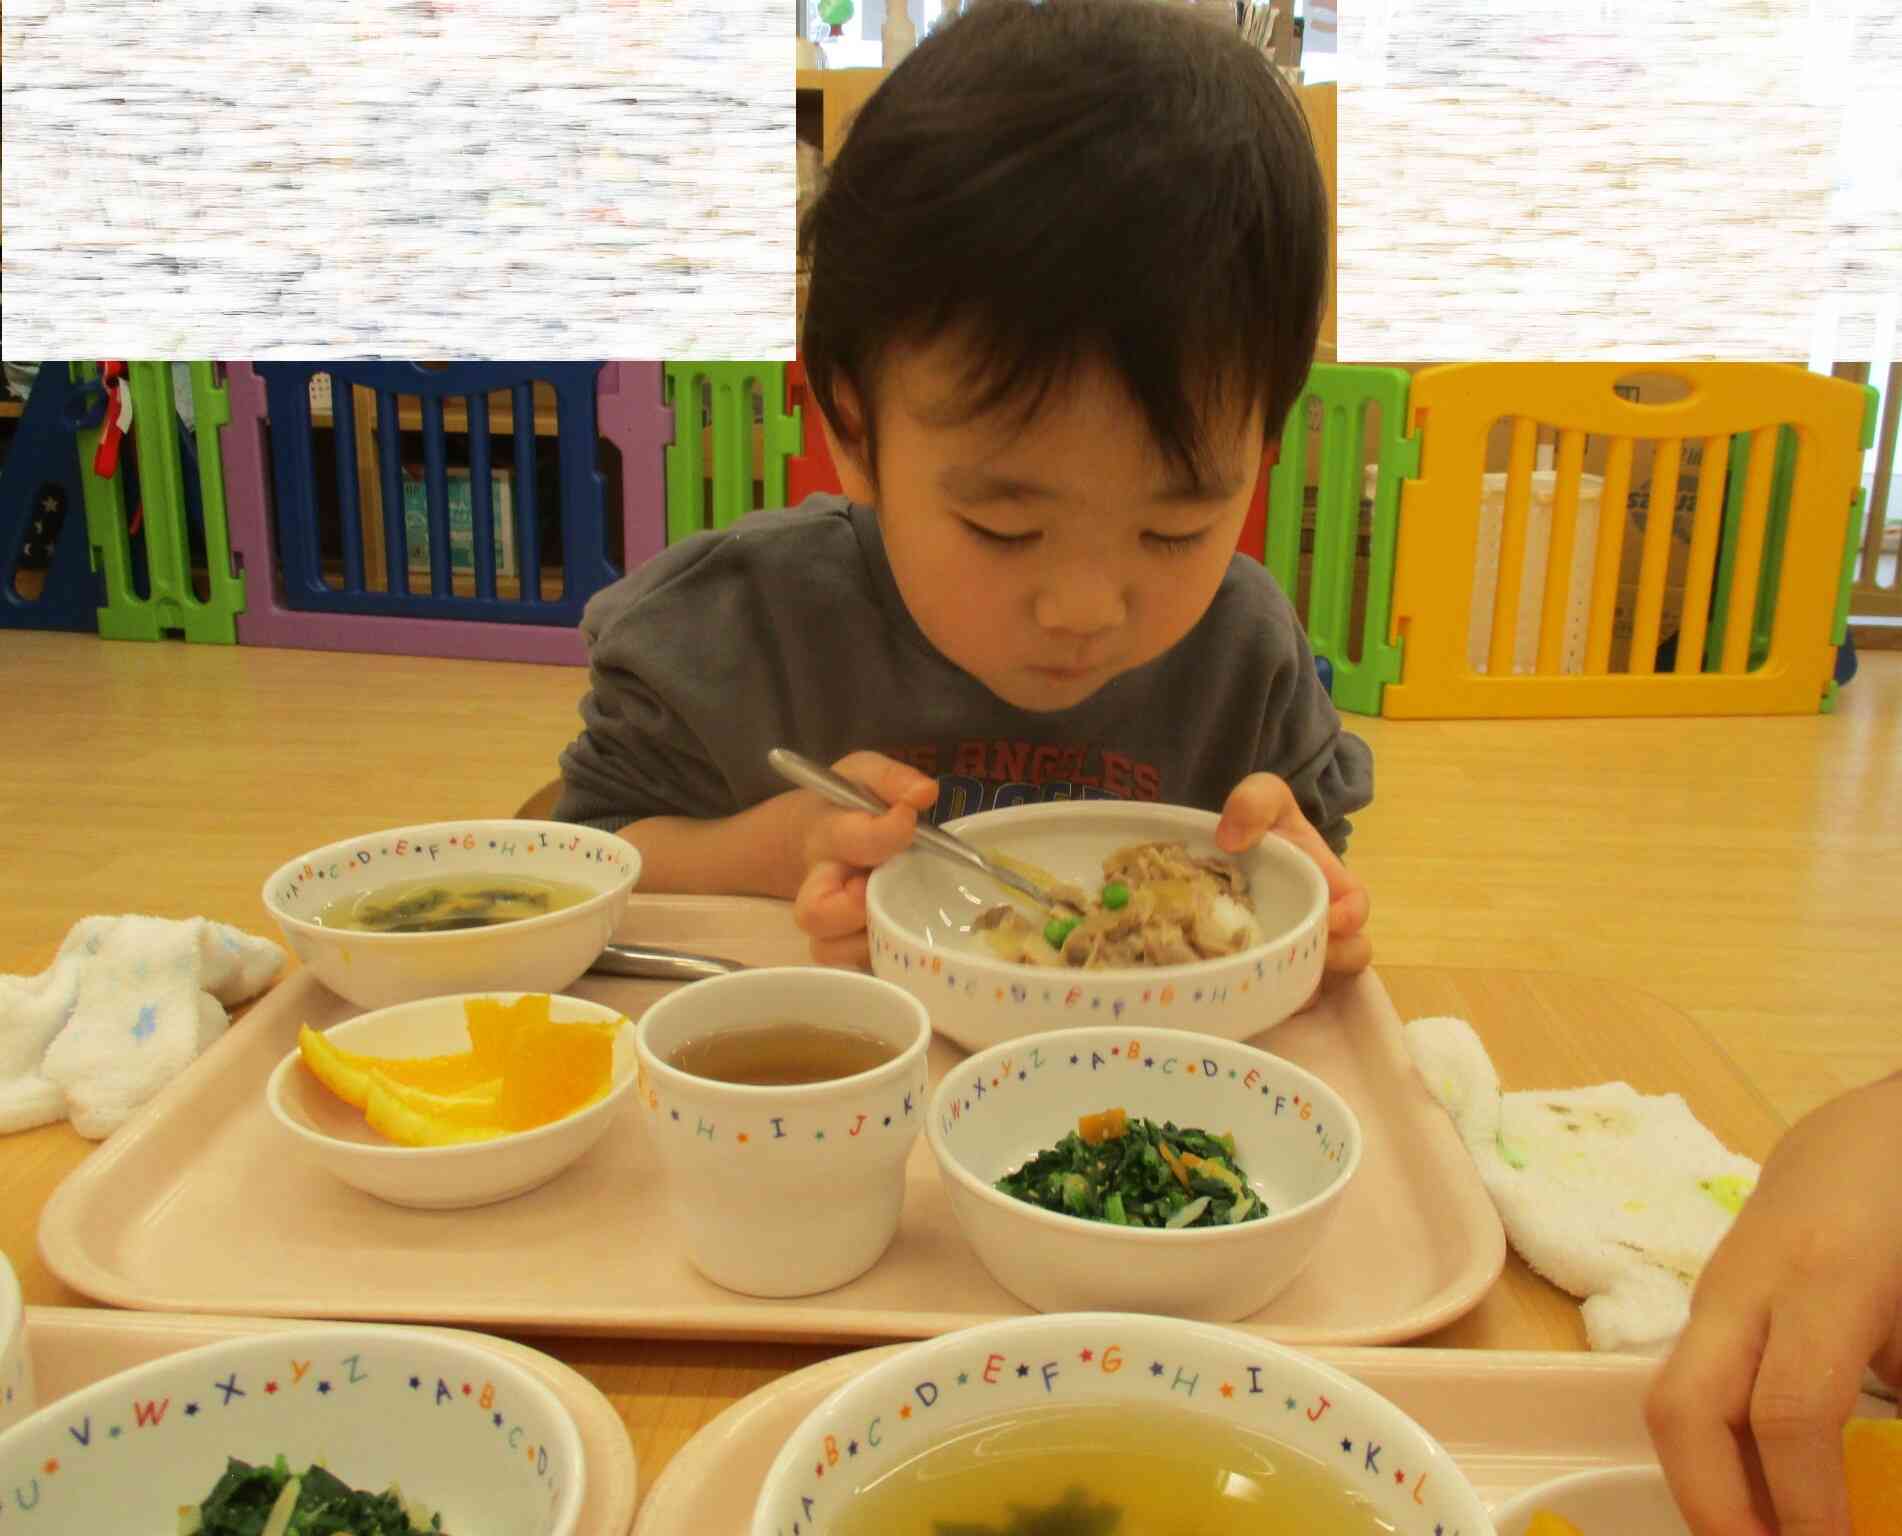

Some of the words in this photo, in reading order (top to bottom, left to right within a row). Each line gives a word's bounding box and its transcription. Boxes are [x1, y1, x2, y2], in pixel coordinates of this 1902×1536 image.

[357, 850, 371, 865] D
[395, 840, 409, 856] E
[428, 845, 440, 862] F
[696, 1119, 716, 1141] H
[770, 1117, 786, 1139] I
[848, 1114, 867, 1136] J
[903, 1090, 913, 1117] K
[973, 1077, 987, 1100] X
[1001, 1057, 1013, 1078] Y
[1030, 1048, 1044, 1069] Z
[1091, 1051, 1105, 1071] A
[1128, 1040, 1141, 1059] B
[1162, 1057, 1177, 1075] C
[1203, 1059, 1218, 1077] D
[1243, 1068, 1260, 1089] E
[1274, 1096, 1287, 1116] F
[15, 1480, 40, 1510] U
[69, 1416, 91, 1446] V
[133, 1396, 170, 1428] W
[214, 1373, 246, 1406] X
[290, 1359, 311, 1384] Y
[340, 1354, 369, 1383] Z
[433, 1377, 454, 1405] A
[479, 1380, 495, 1409] B
[508, 1426, 524, 1449] C
[537, 1445, 549, 1475] D
[824, 1434, 840, 1467] B
[868, 1417, 881, 1447] C
[915, 1381, 938, 1407] D
[983, 1354, 1006, 1384] E
[1041, 1362, 1059, 1392] F
[1101, 1345, 1123, 1373] G
[1170, 1367, 1199, 1397] H
[1246, 1366, 1264, 1393] I
[1306, 1395, 1331, 1422] J
[1364, 1441, 1382, 1474] K
[1412, 1472, 1427, 1505] L
